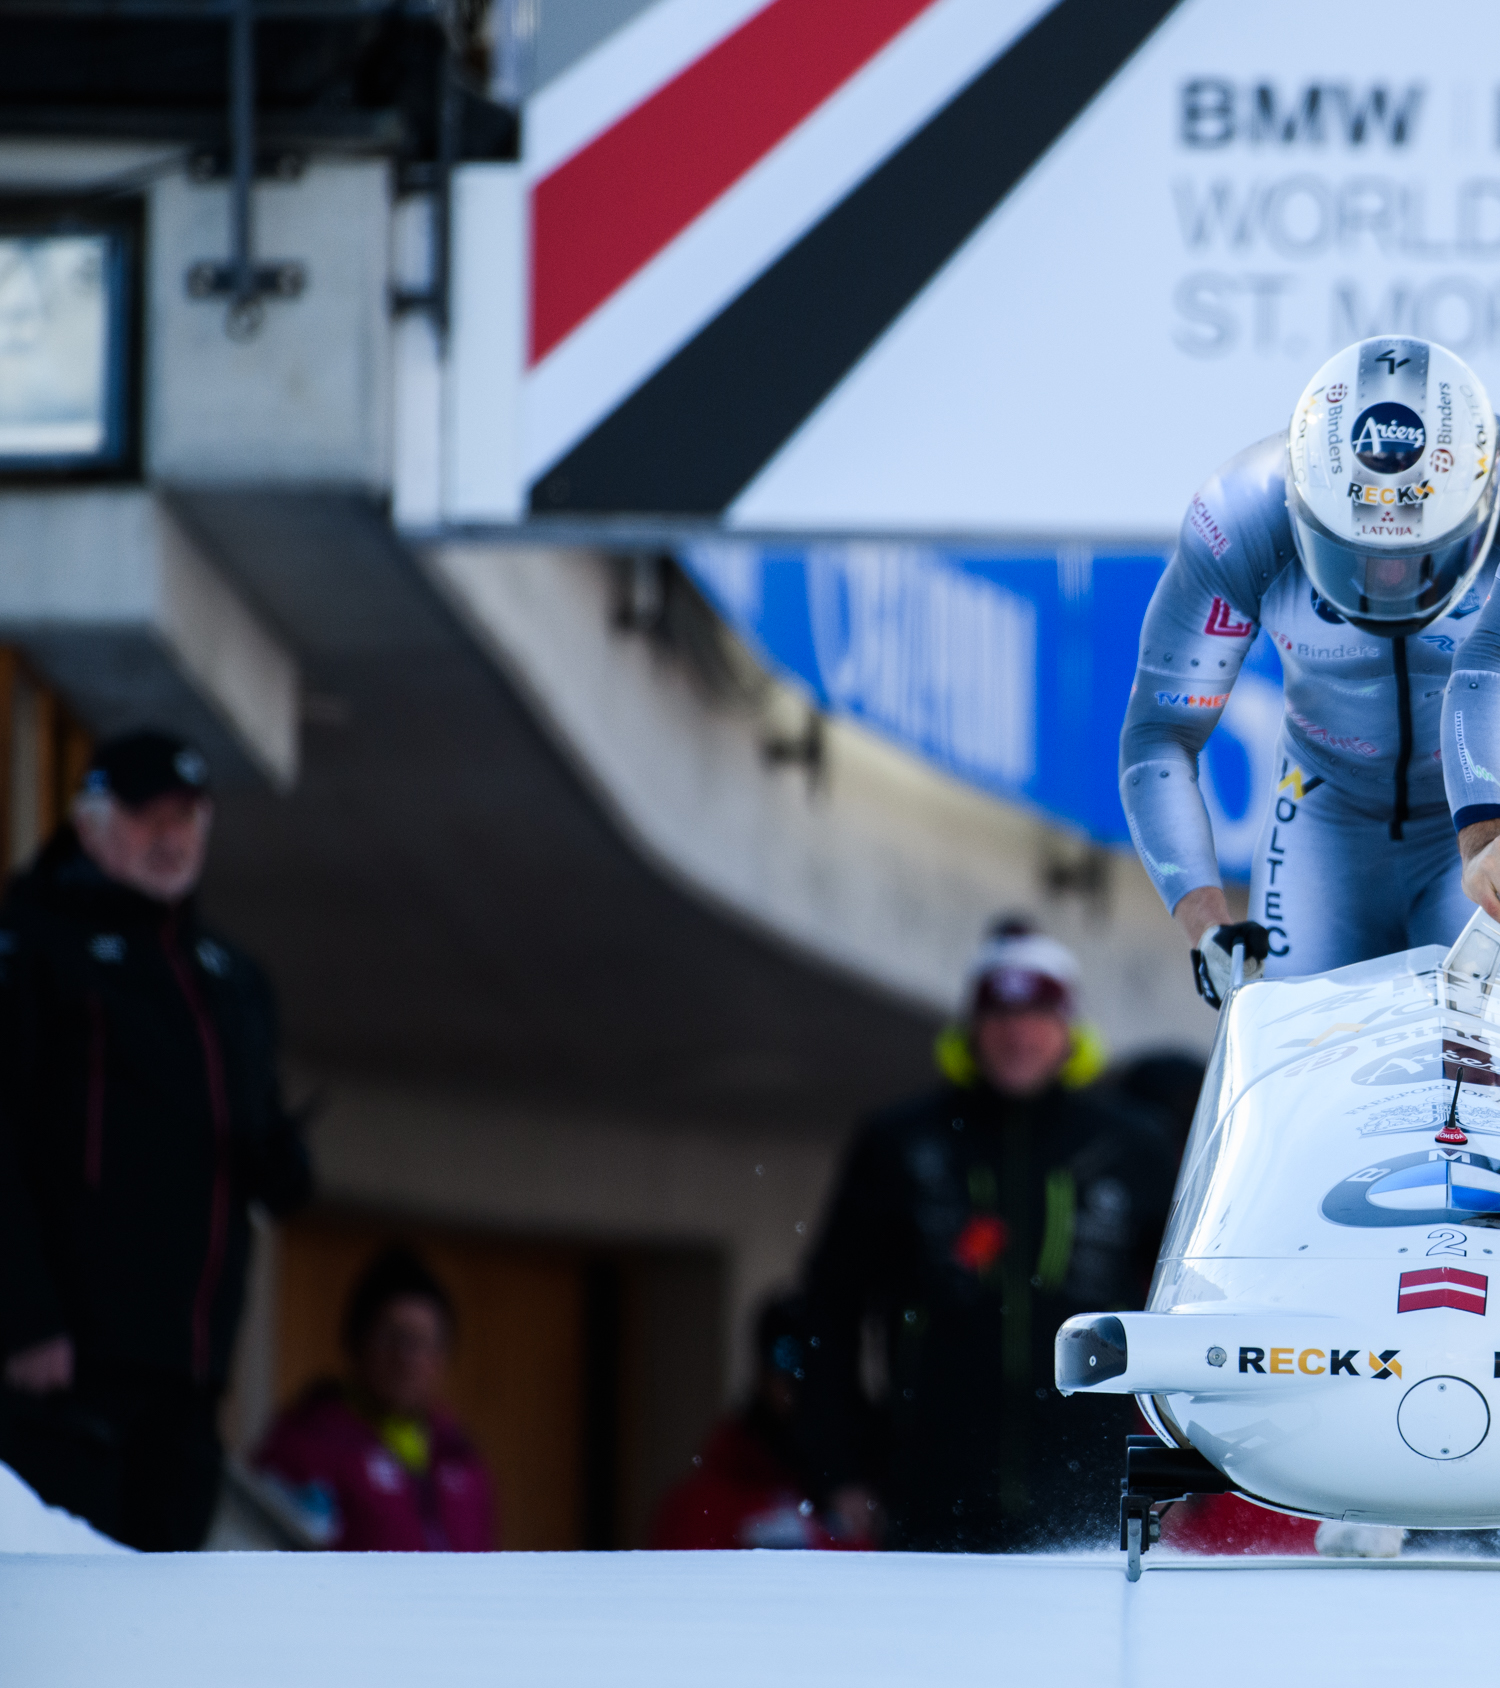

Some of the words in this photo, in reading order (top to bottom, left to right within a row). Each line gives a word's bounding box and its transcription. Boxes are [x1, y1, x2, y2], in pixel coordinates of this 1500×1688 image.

[1178, 80, 1424, 150] BMW
[1174, 274, 1312, 357] ST.
[1362, 525, 1412, 536] LATVIJA
[1345, 1084, 1453, 1115] FREEPORT
[1462, 1088, 1492, 1099] OF
[1439, 1132, 1465, 1140] OMEGA
[1425, 1228, 1468, 1257] 2
